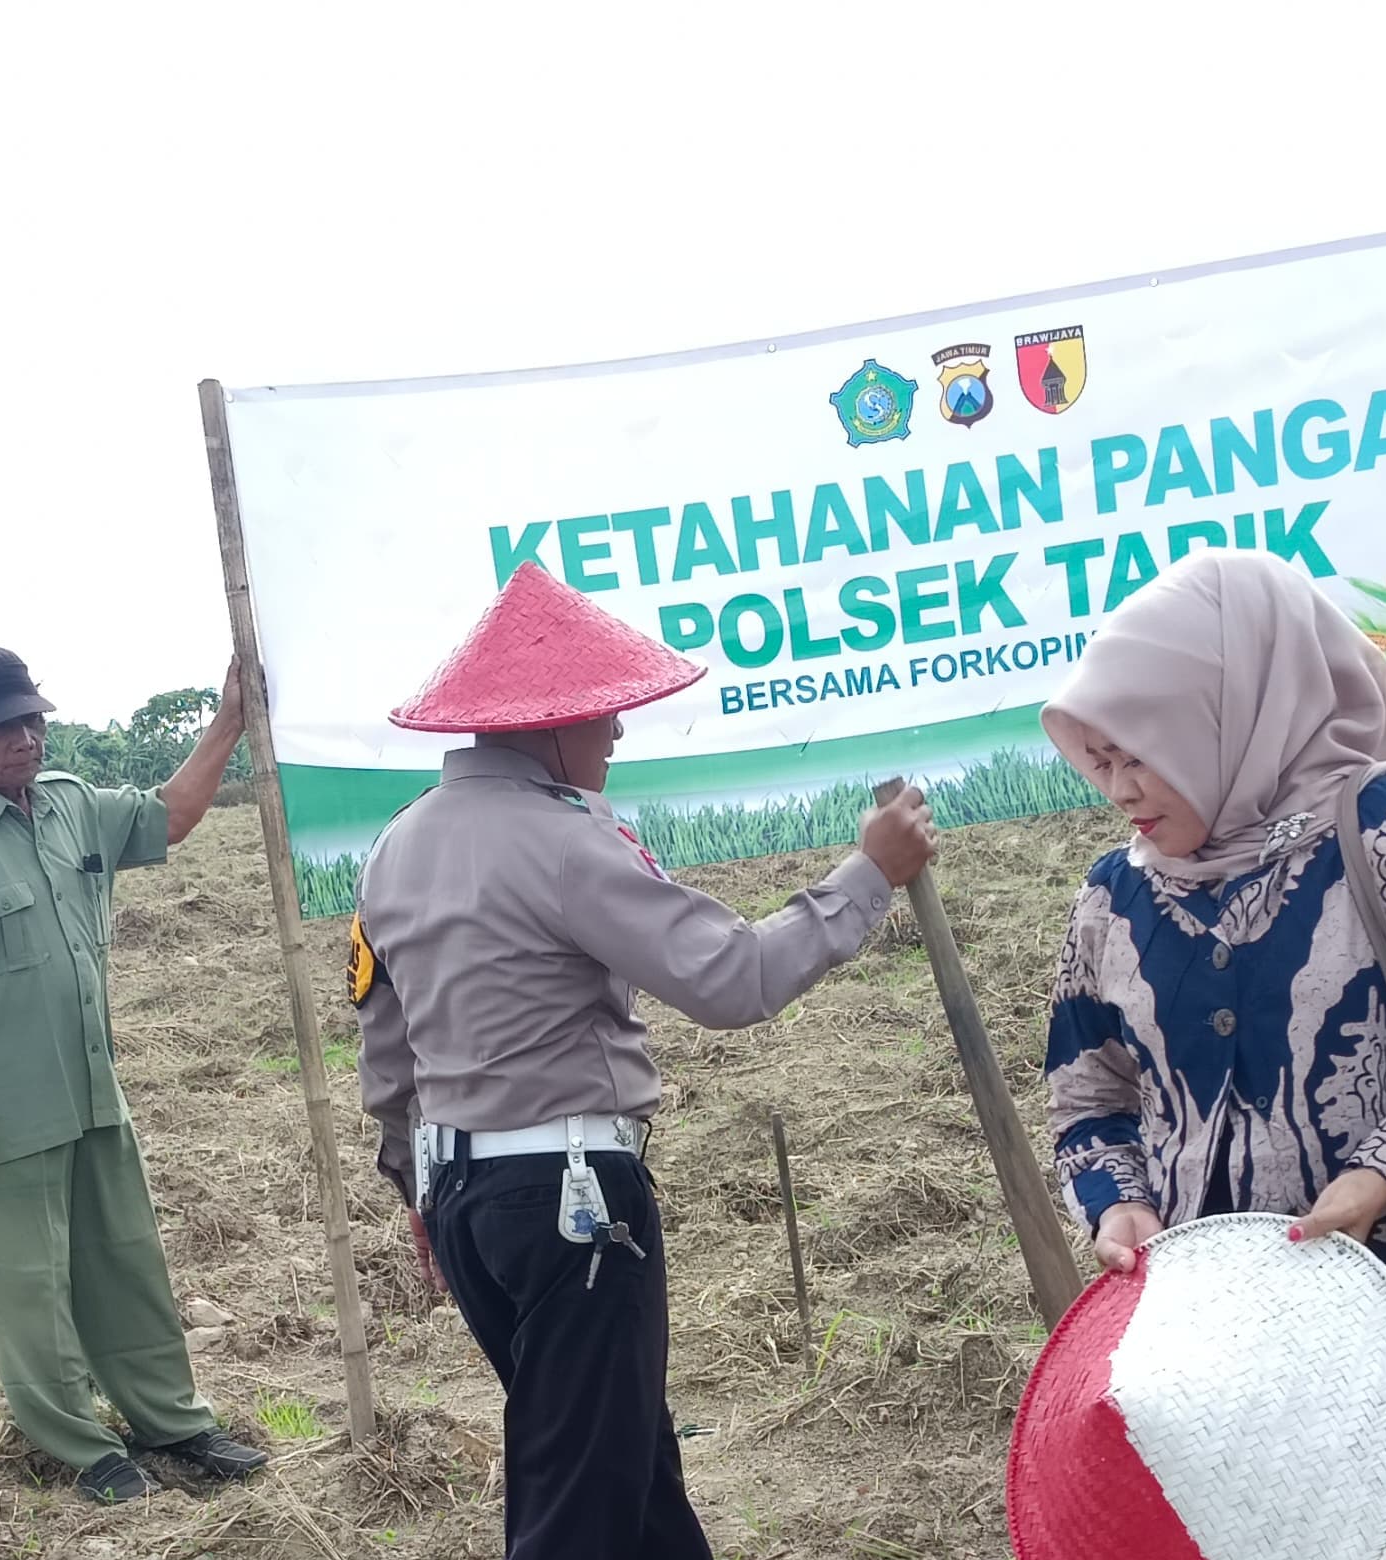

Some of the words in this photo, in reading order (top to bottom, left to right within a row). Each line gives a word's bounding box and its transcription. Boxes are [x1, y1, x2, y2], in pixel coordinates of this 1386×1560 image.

[934, 349, 960, 364] JAWA
[961, 346, 989, 357] TIMUR
[1015, 327, 1082, 347] BRAWIJAYA
[489, 447, 1063, 592] KETAHANAN
[659, 551, 1026, 668] POLSEK
[720, 663, 901, 715] BERSAMA
